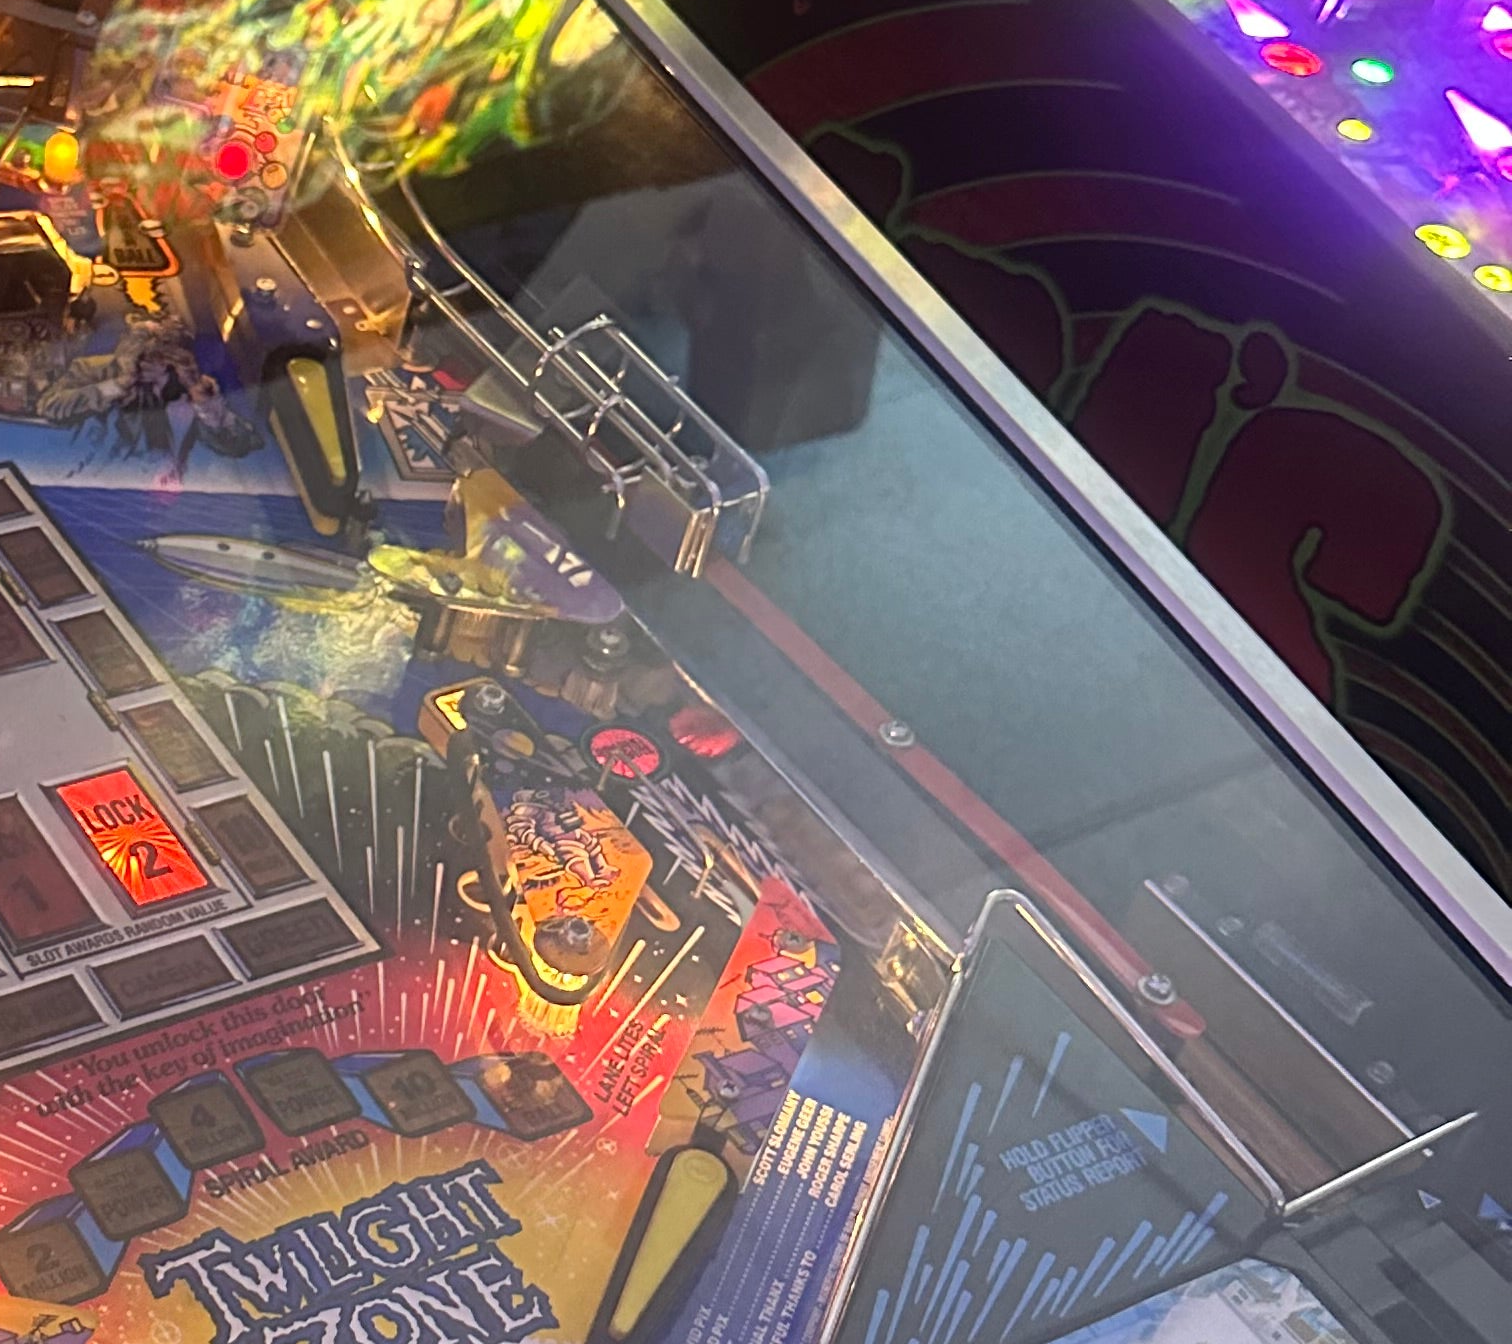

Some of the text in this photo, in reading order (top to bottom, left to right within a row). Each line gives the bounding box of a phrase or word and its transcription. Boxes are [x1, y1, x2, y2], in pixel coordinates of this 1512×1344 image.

[80, 792, 153, 837] LOCK
[129, 839, 172, 882] 2
[65, 928, 124, 957] AWARDS
[125, 911, 183, 940] RANDOM
[184, 897, 228, 924] VALUE
[221, 1005, 267, 1032] this
[594, 1019, 646, 1105] LANE LITES
[612, 1027, 668, 1118] LEFT SPIRAL
[202, 1128, 373, 1199] SPIRAL AWARD
[753, 1146, 777, 1186] SCOTT
[777, 1097, 818, 1176] EUGENE GEER
[797, 1145, 818, 1180] JOHN
[808, 1112, 851, 1199] ROGER SHARPE
[824, 1169, 849, 1208] CAROL
[840, 1120, 867, 1170] SERLING
[999, 1113, 1117, 1171] HOLD FLIPPER
[1025, 1130, 1138, 1185] BUTTON FOR
[1019, 1147, 1149, 1212] STATUS REPORT
